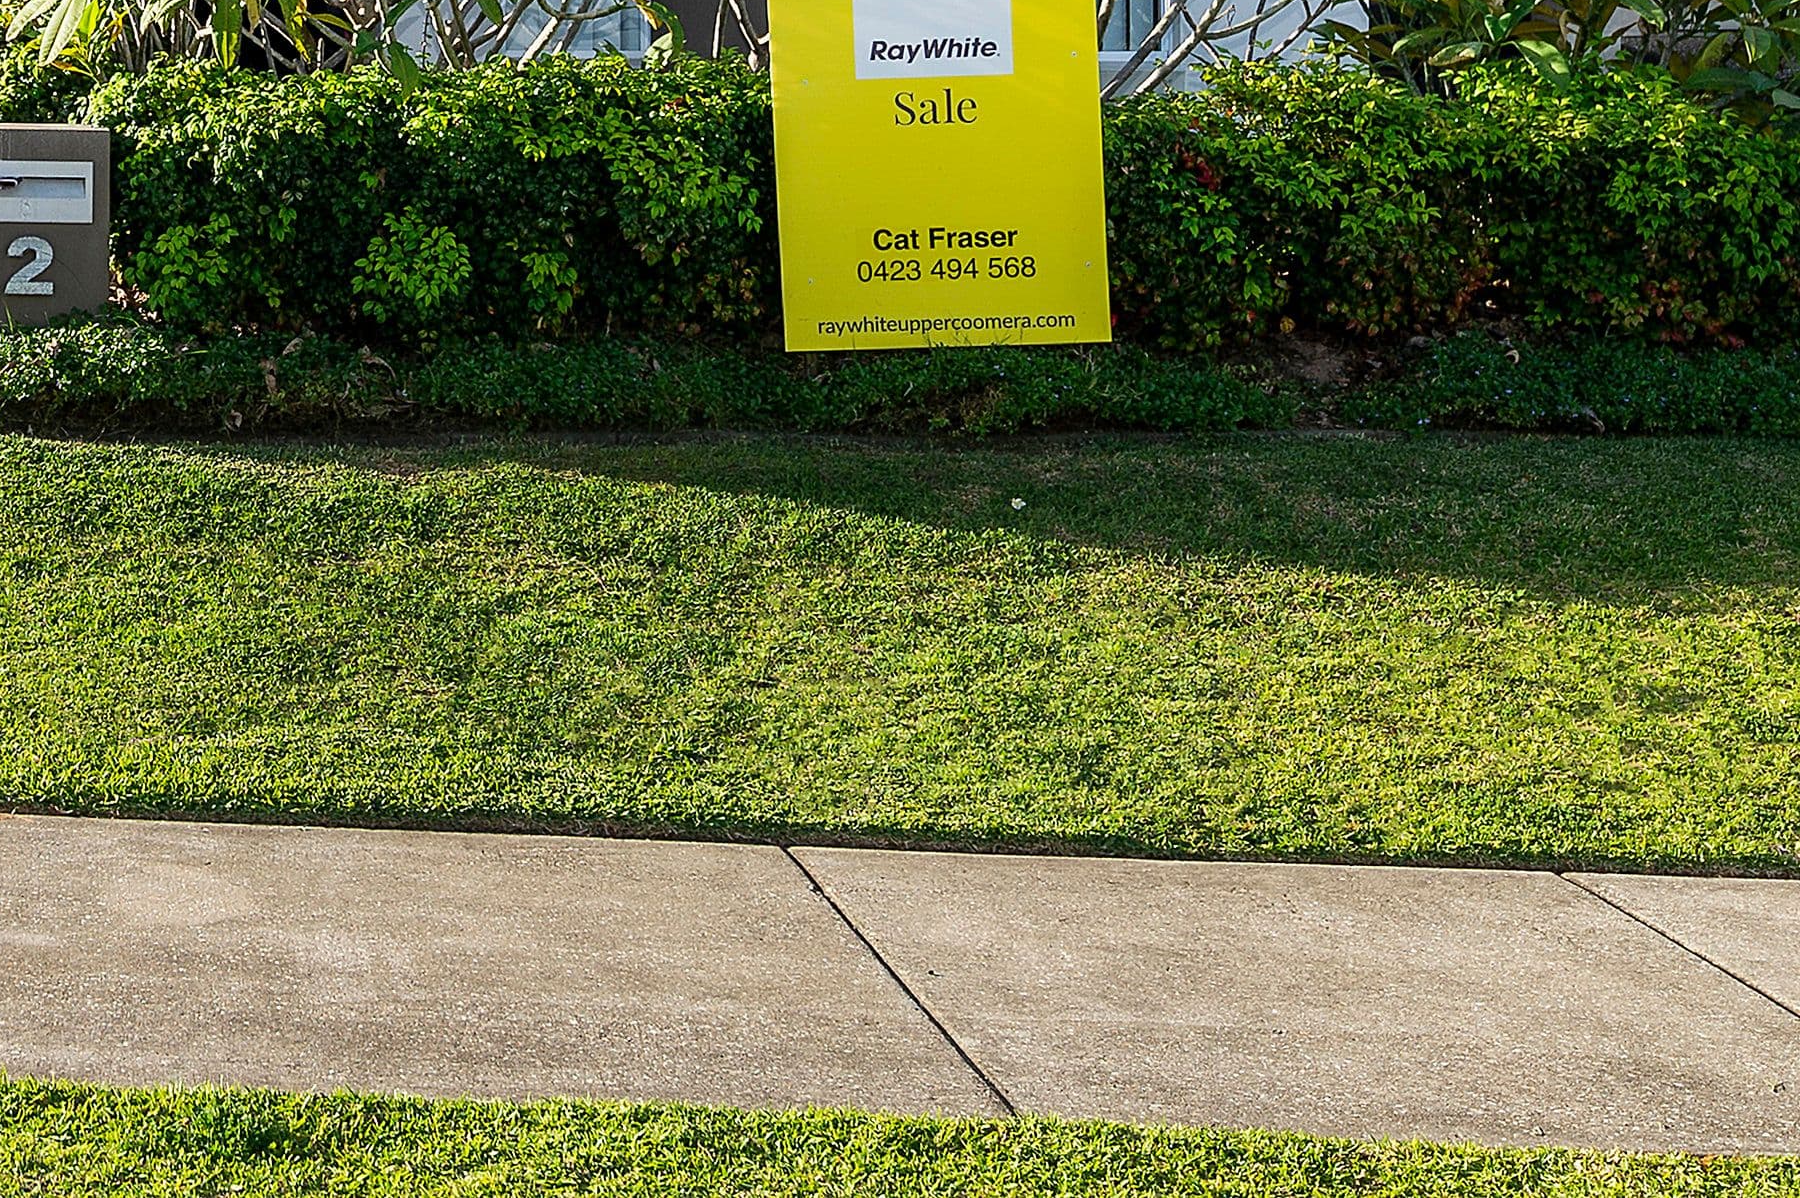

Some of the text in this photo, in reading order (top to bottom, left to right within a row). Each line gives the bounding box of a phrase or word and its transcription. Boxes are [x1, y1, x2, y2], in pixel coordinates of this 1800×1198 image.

[894, 88, 978, 126] Sale
[873, 227, 1018, 251] Cat Fraser
[4, 236, 54, 295] 2
[856, 256, 1036, 283] 0423 494 568
[818, 314, 1076, 336] raywhiteuppercoomera.com
